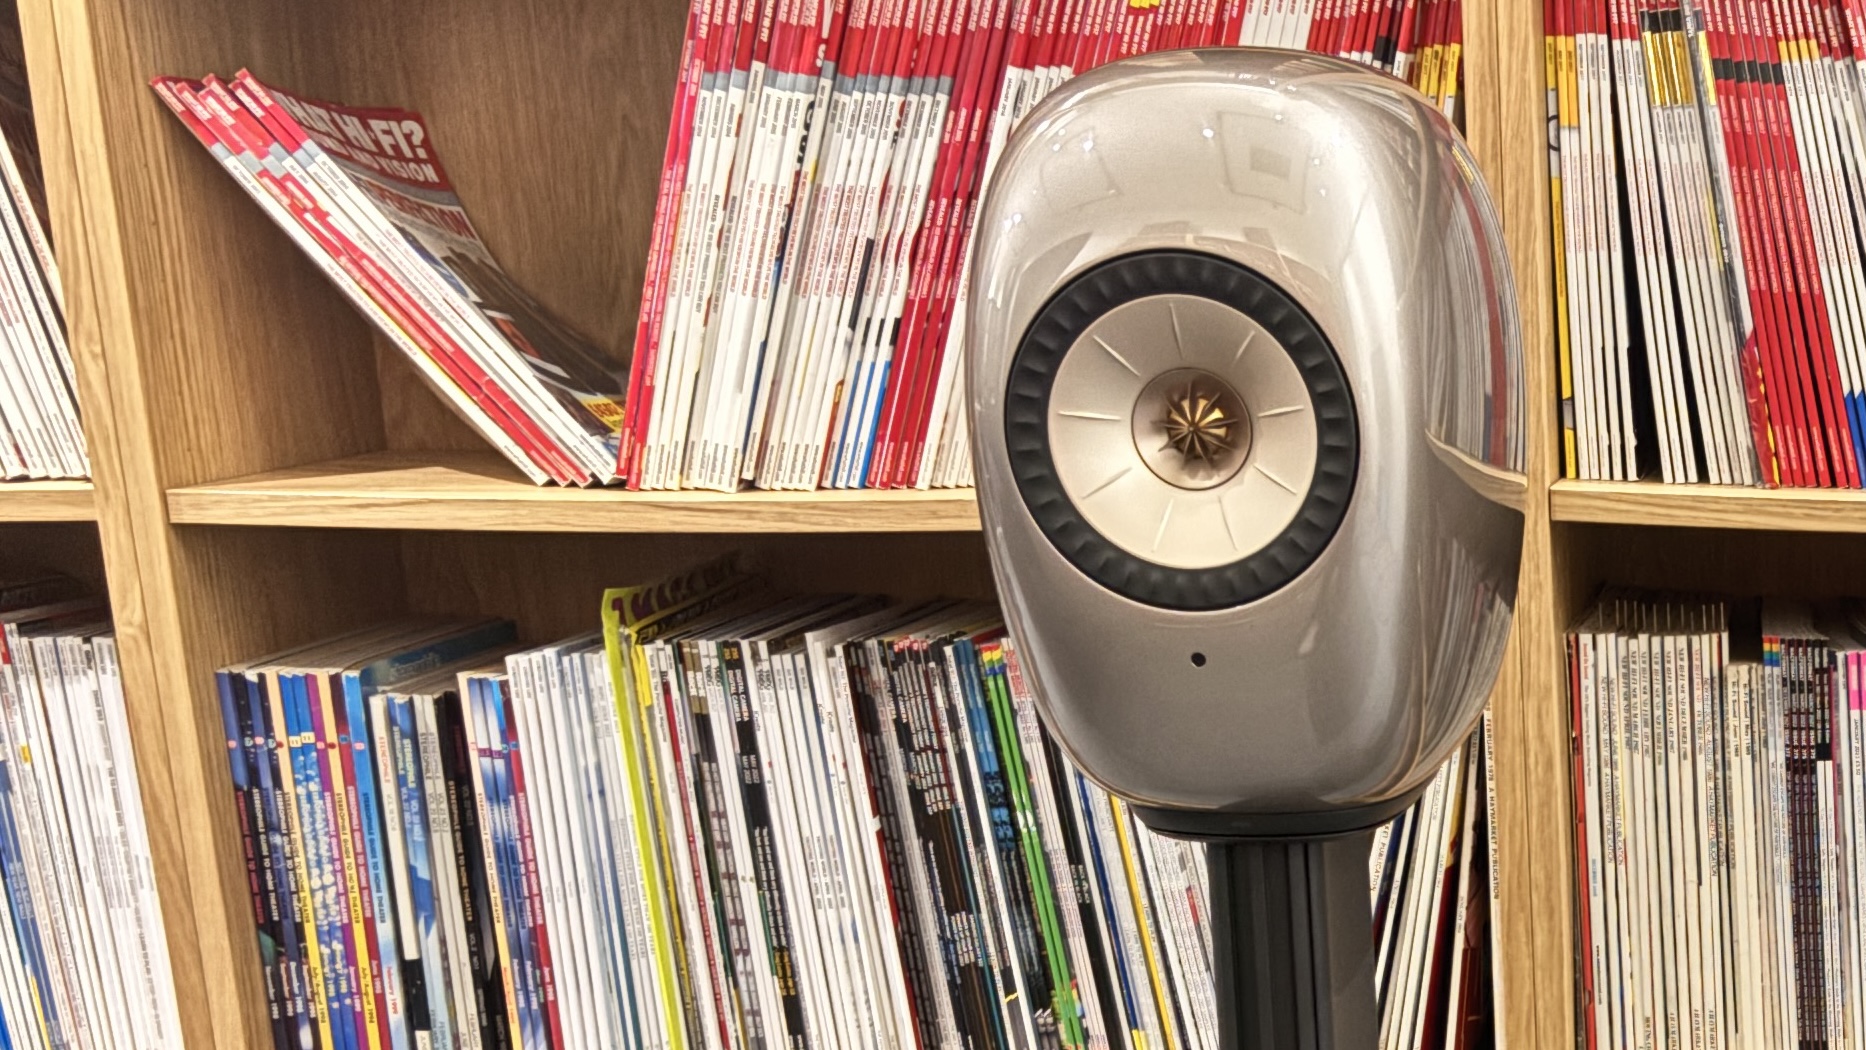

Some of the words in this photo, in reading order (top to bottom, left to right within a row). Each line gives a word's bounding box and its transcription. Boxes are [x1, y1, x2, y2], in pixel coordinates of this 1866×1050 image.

[373, 155, 440, 183] VISION
[1485, 718, 1493, 760] FEBRUARY
[401, 738, 416, 788] STEREOPHILE
[323, 791, 336, 835] STEREOPHILE
[335, 792, 347, 835] STEREOPHILE
[346, 785, 359, 829] STEREOPHILE
[361, 792, 374, 835] STEREOPHILE
[446, 780, 460, 829] STEREOPHILE
[517, 792, 530, 836] STEREOPHILE
[1488, 796, 1496, 844] HAYMARKET
[330, 836, 339, 858] GUIDE
[341, 838, 351, 859] GUIDE
[352, 831, 363, 852] GUIDE
[367, 837, 377, 859] GUIDE
[454, 831, 463, 853] GUIDE
[524, 837, 533, 858] GUIDE
[333, 860, 341, 870] TO
[345, 861, 352, 870] TO
[356, 854, 364, 864] TO
[371, 861, 379, 871] TO
[457, 855, 465, 864] TO
[527, 861, 535, 871] TO
[335, 872, 344, 893] HOME
[347, 872, 356, 893] HOME
[357, 865, 368, 887] HOME
[372, 872, 382, 893] HOME
[458, 866, 468, 887] HOME
[529, 872, 538, 894] HOME
[1491, 848, 1499, 899] PUBLICATION
[338, 895, 349, 923] THEATER
[350, 895, 360, 923] THEATER
[361, 888, 372, 918] THEATER
[375, 895, 386, 923] THEATER
[461, 888, 473, 921] THEATER
[532, 896, 543, 924] THEATER
